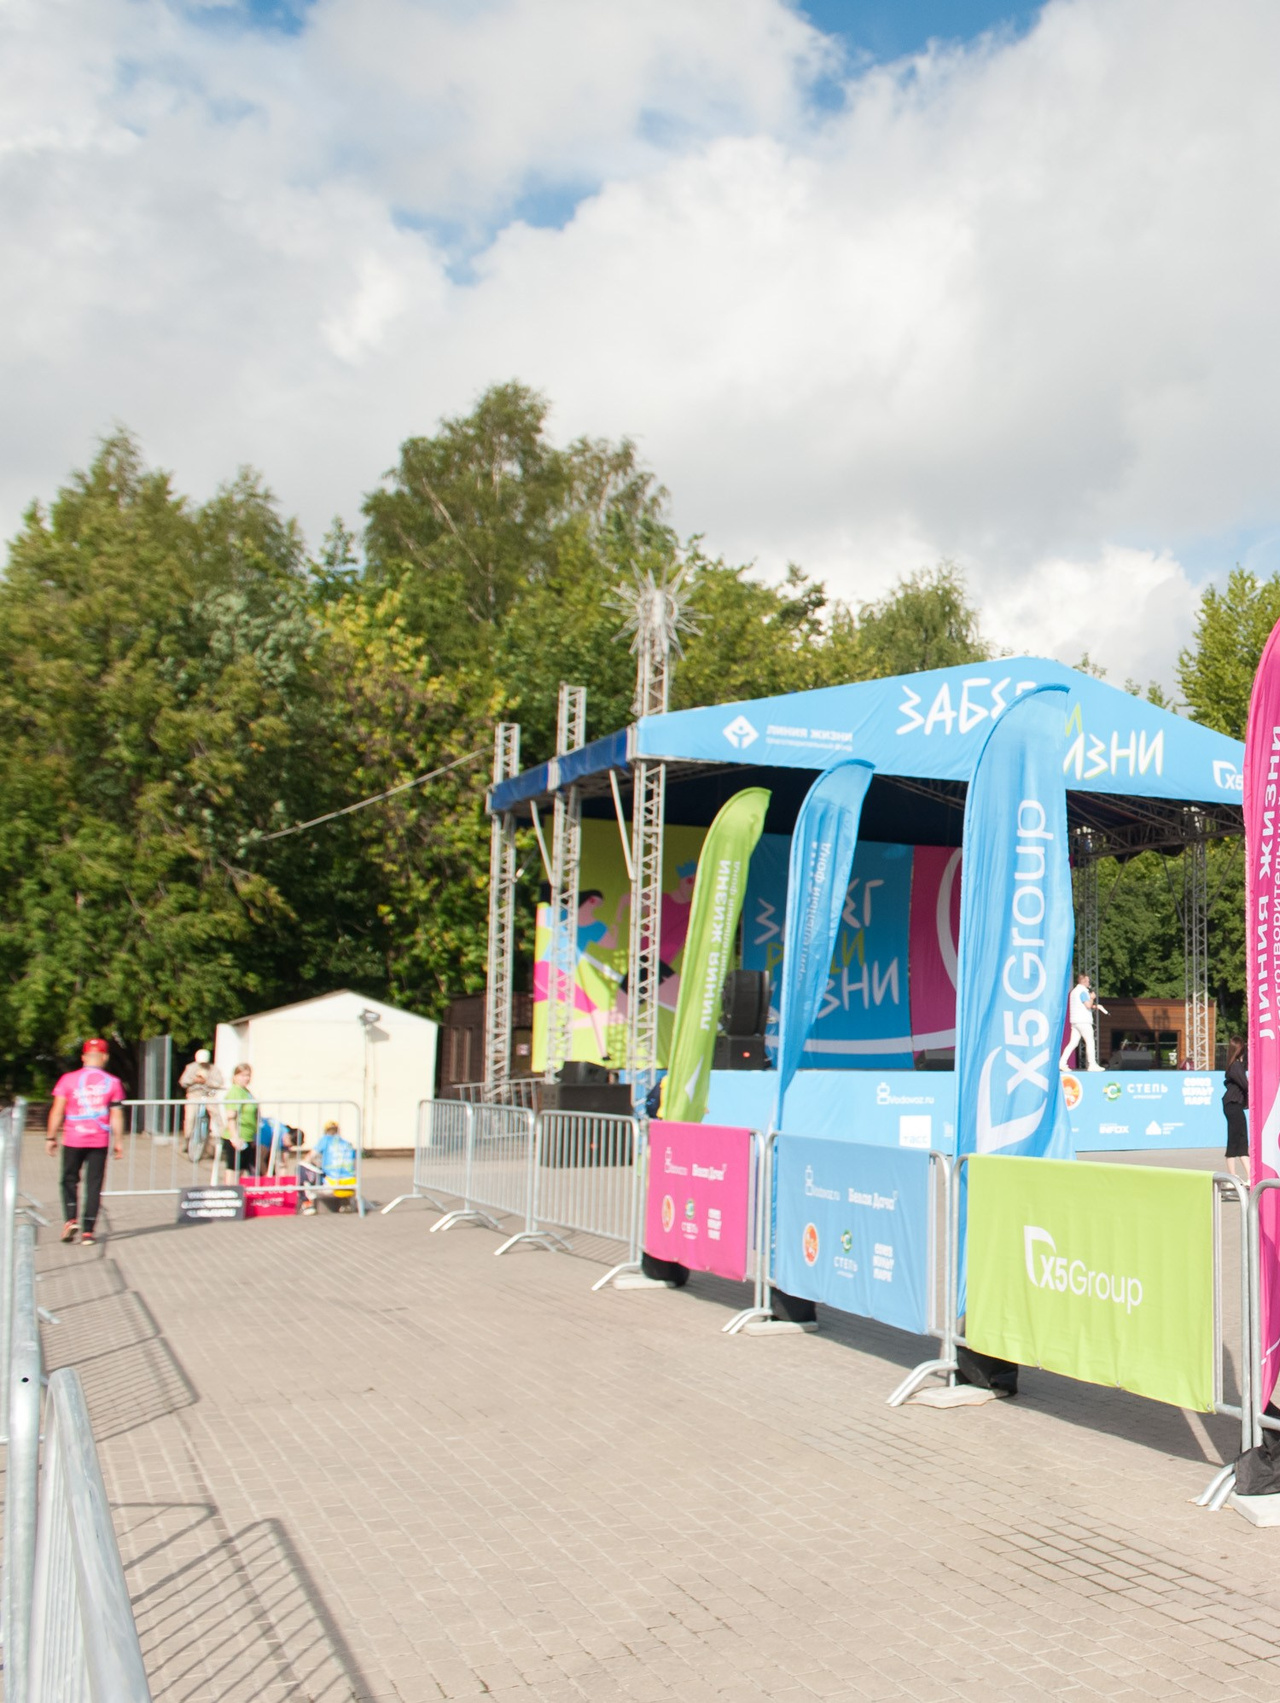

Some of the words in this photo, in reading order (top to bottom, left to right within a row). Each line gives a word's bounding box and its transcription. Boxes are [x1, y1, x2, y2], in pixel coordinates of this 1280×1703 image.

[896, 677, 1037, 735] ЗАБЕ
[810, 728, 853, 742] ЖИЗНИ
[1063, 728, 1164, 781] ИЗНИ
[813, 841, 832, 884] фонд
[701, 952, 720, 1032] ЛИНИЯ
[711, 859, 731, 949] ЖИЗНИ
[1259, 895, 1276, 1041] ЛИНИЯ
[1126, 1083, 1169, 1094] СТЕПЬ
[833, 1255, 858, 1272] СТЕПЬ
